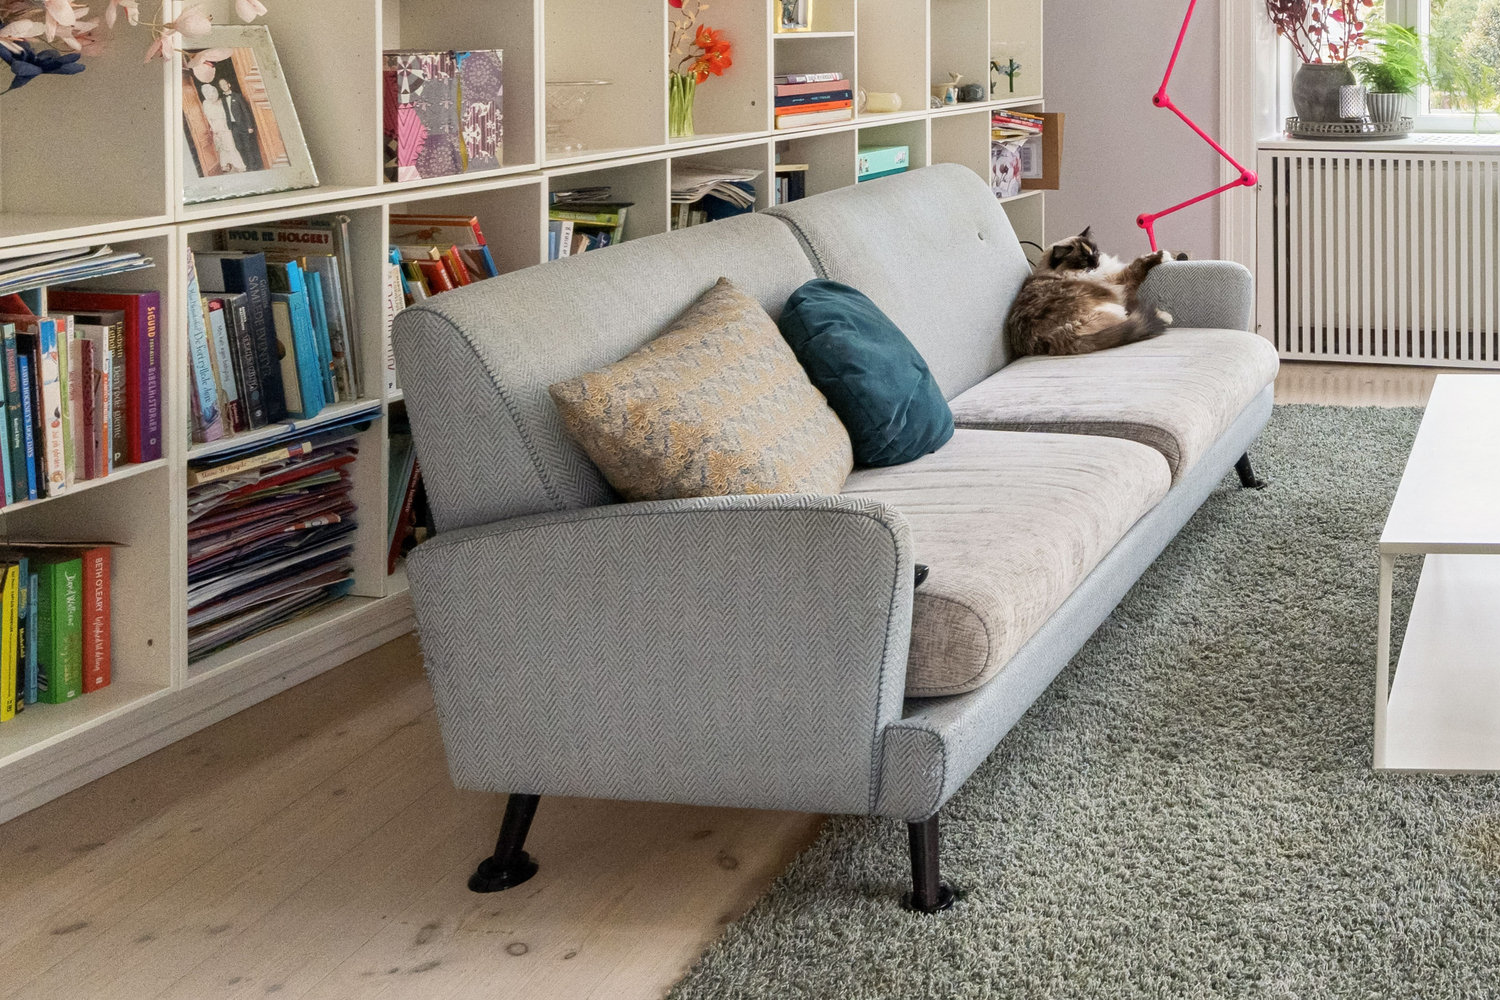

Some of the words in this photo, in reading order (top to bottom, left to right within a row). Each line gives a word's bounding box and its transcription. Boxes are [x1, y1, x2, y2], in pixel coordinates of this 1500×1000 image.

[277, 232, 329, 245] HOLGER?
[249, 275, 264, 324] SAMLEDE
[195, 331, 204, 343] De
[196, 344, 211, 386] fortryllede
[23, 389, 31, 424] HOCKNEY'S
[113, 383, 121, 406] røde
[112, 408, 121, 438] glente
[95, 557, 103, 578] BETH
[95, 580, 103, 612] O'LEARY
